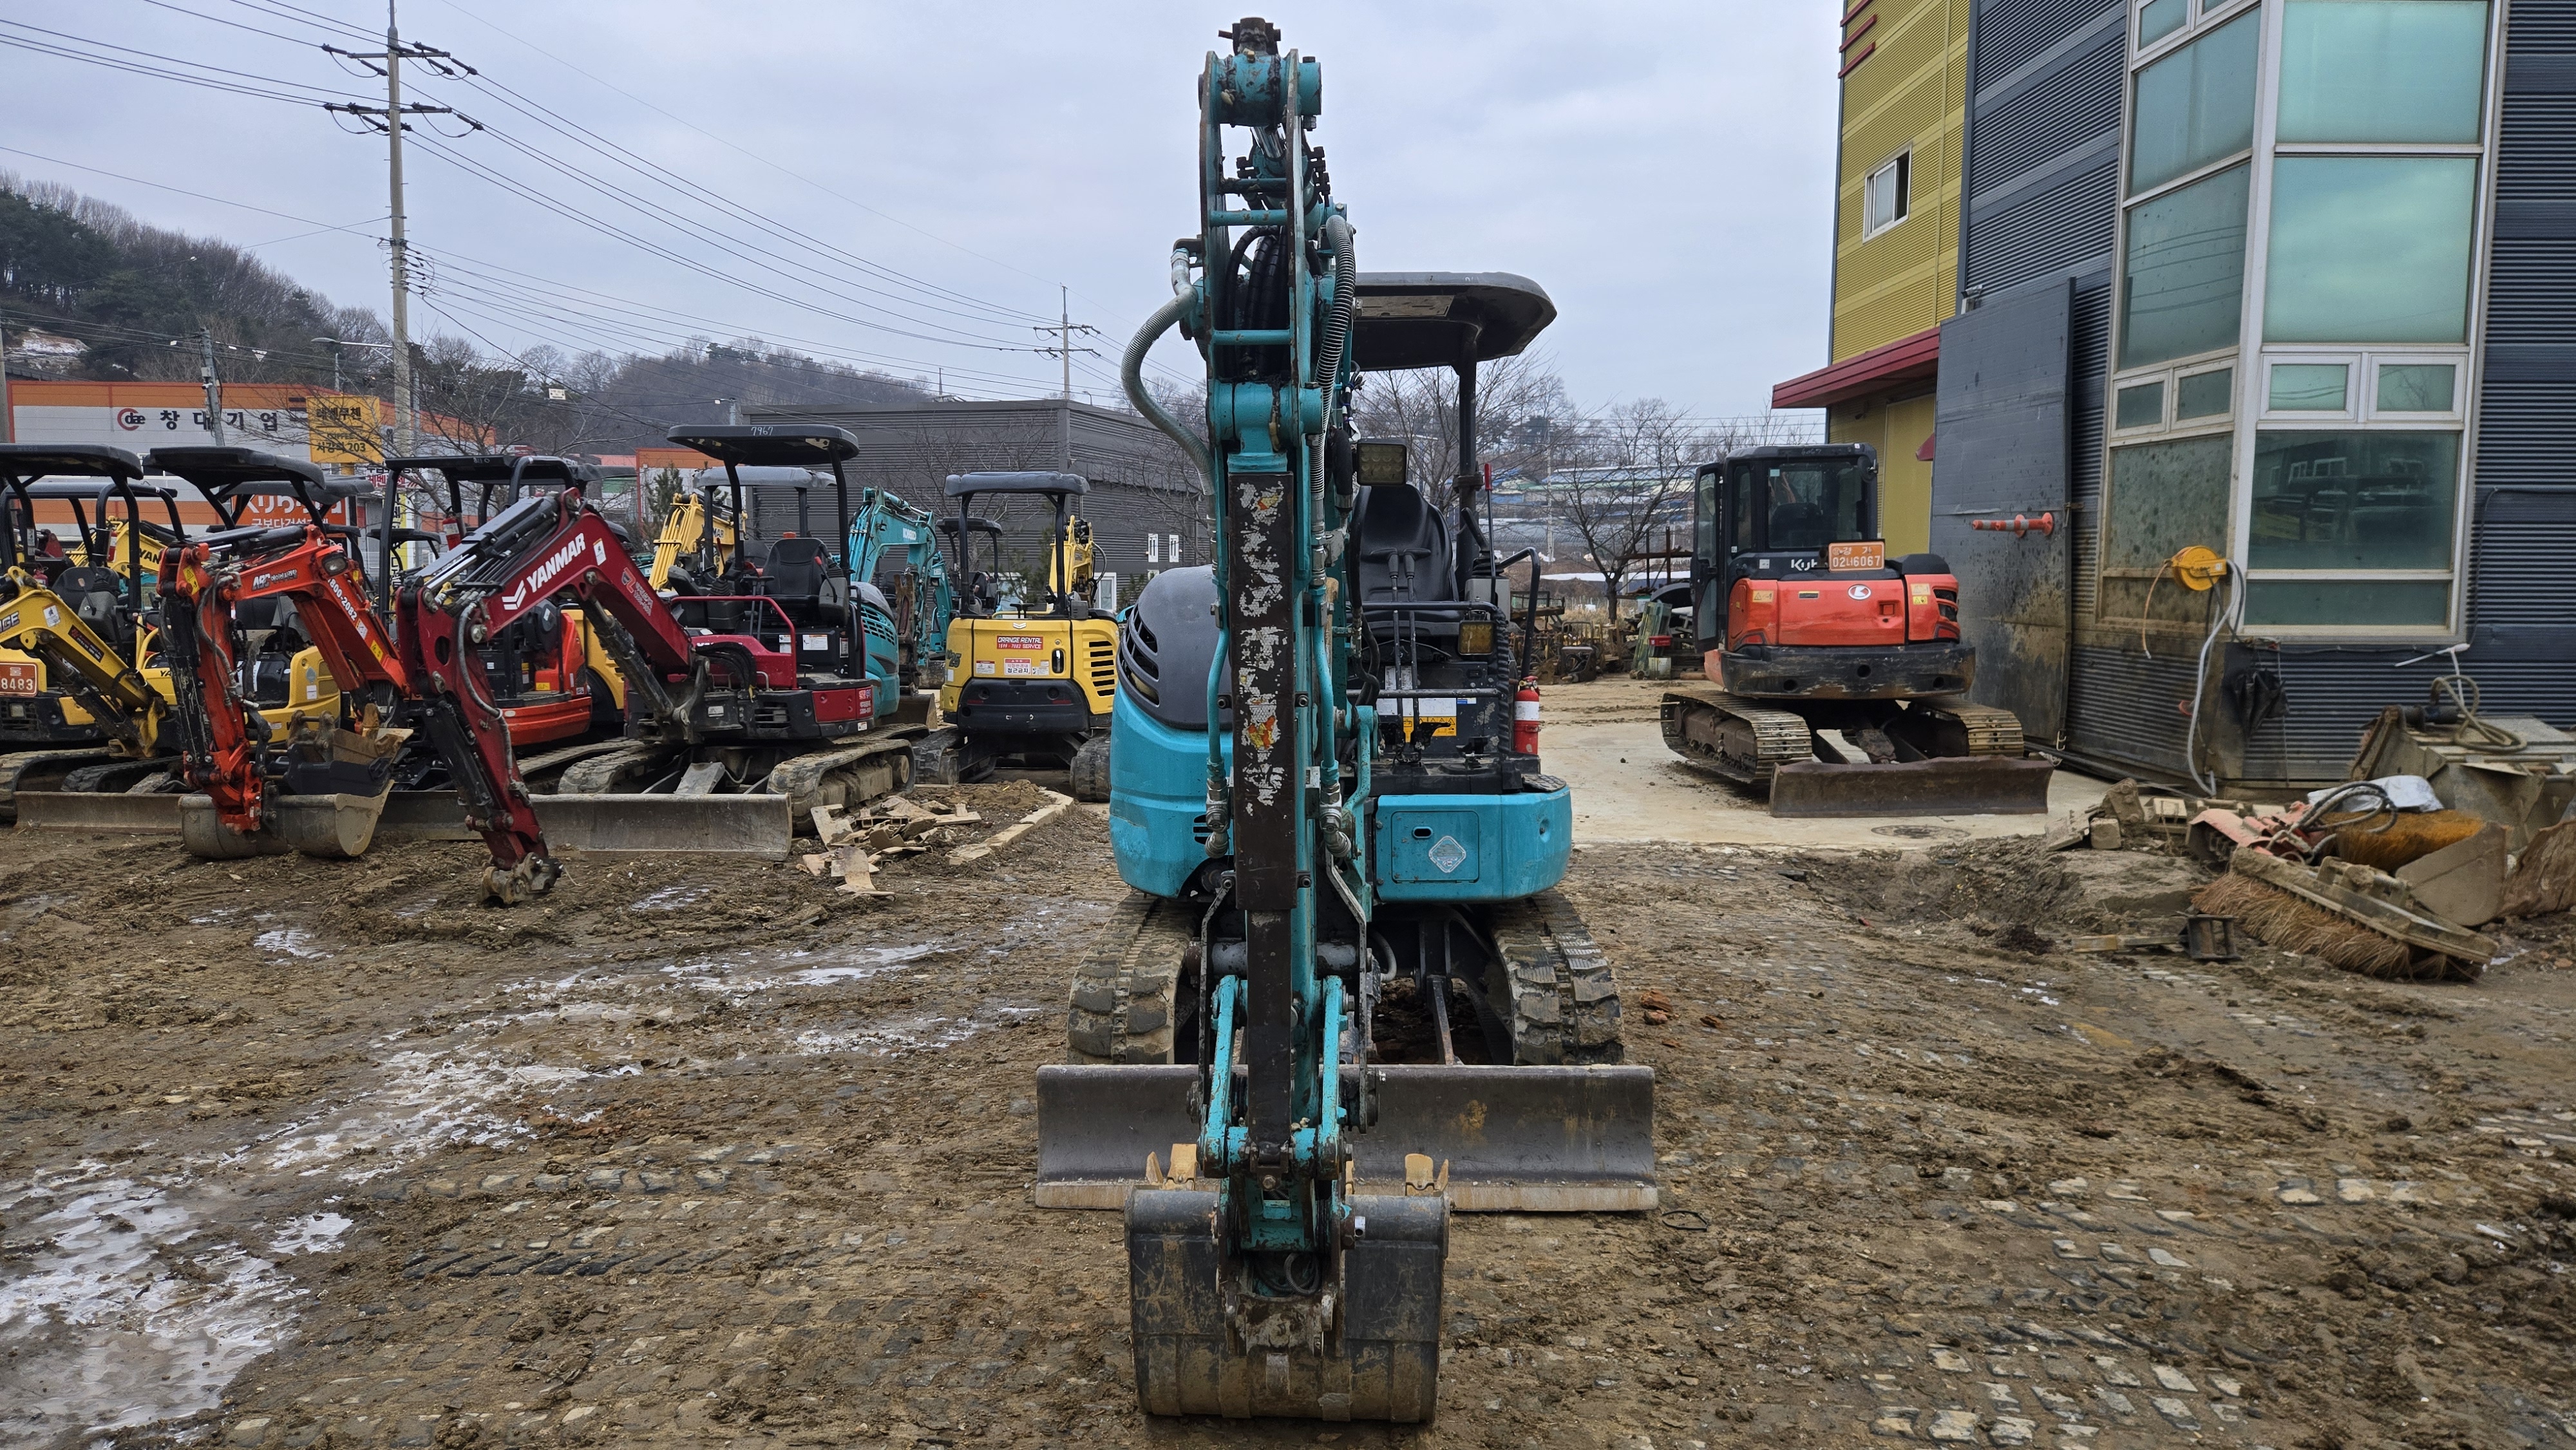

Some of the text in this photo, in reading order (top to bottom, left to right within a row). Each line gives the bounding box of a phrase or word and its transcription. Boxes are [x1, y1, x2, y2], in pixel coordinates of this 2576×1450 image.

[751, 426, 773, 436] 7967
[348, 442, 366, 452] 203
[527, 533, 586, 593] YANMAR
[1, 678, 33, 690] 8483
